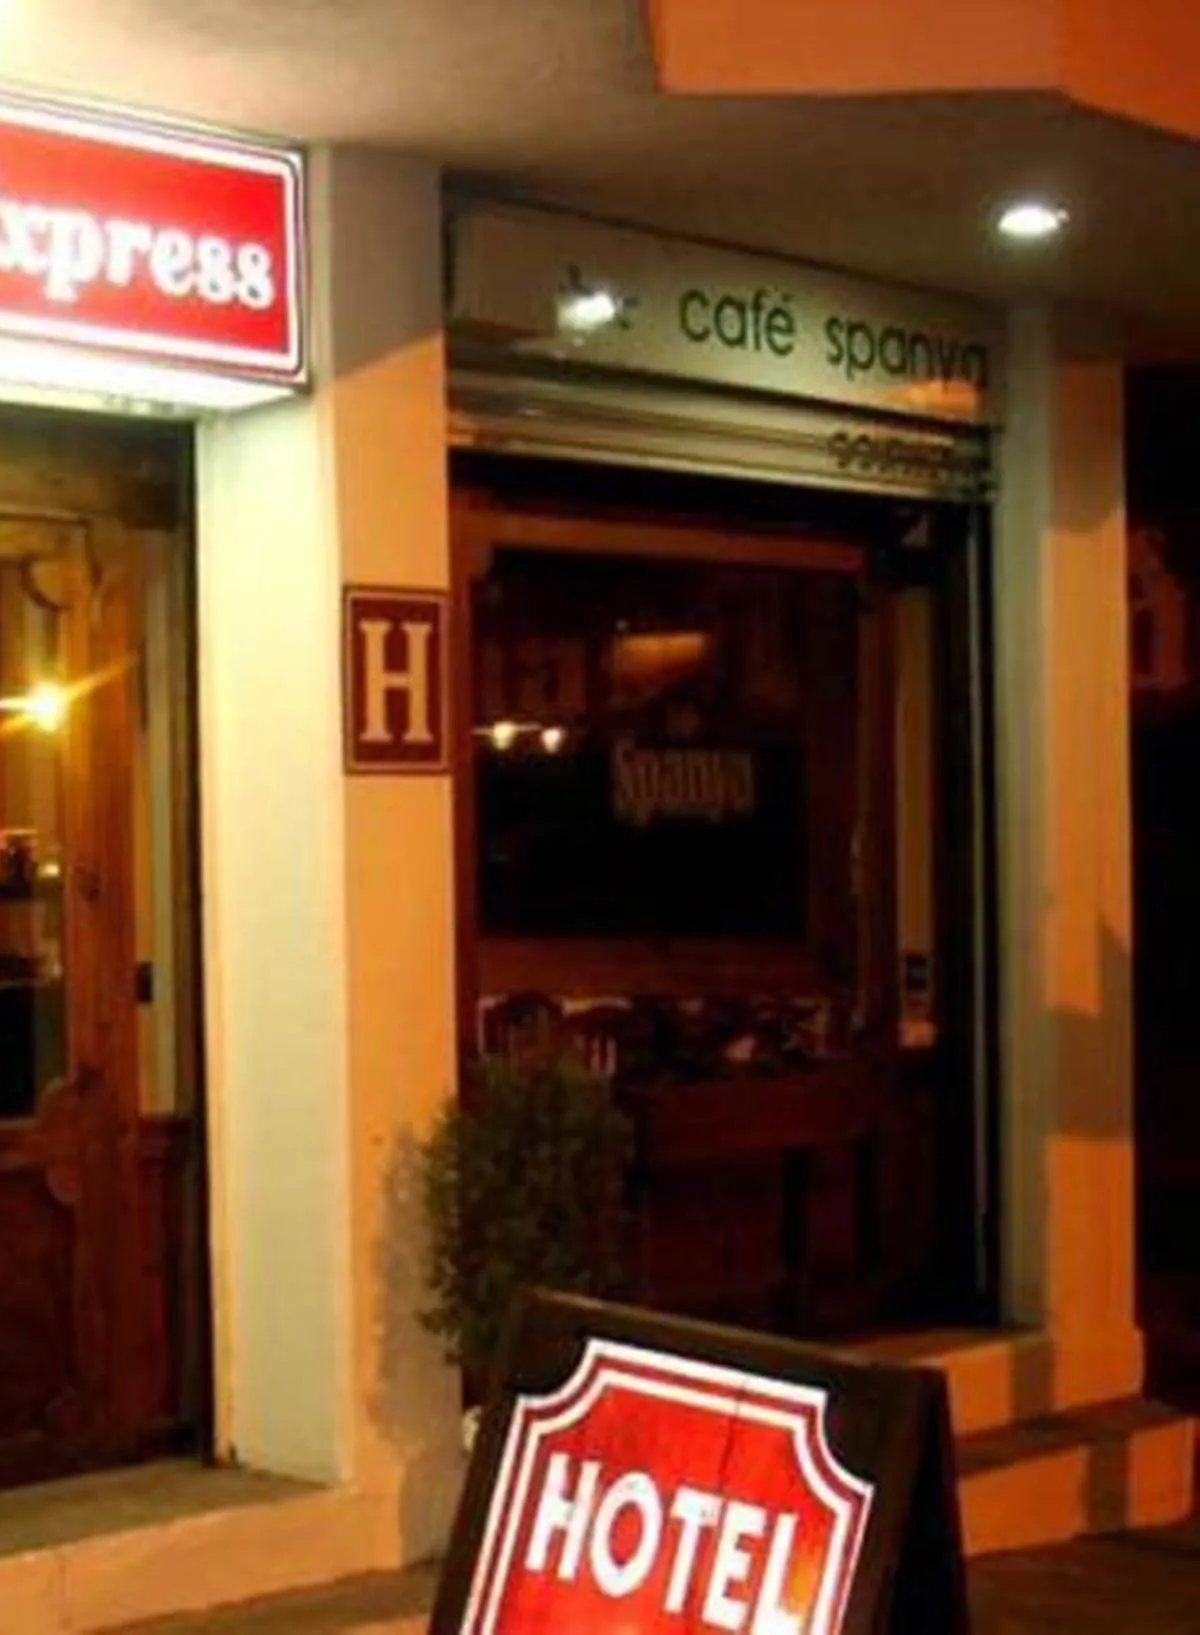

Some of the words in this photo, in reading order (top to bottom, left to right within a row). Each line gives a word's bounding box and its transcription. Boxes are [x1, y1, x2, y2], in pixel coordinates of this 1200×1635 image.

[679, 282, 796, 359] café
[358, 618, 433, 745] H
[525, 1452, 801, 1635] HOTEL
